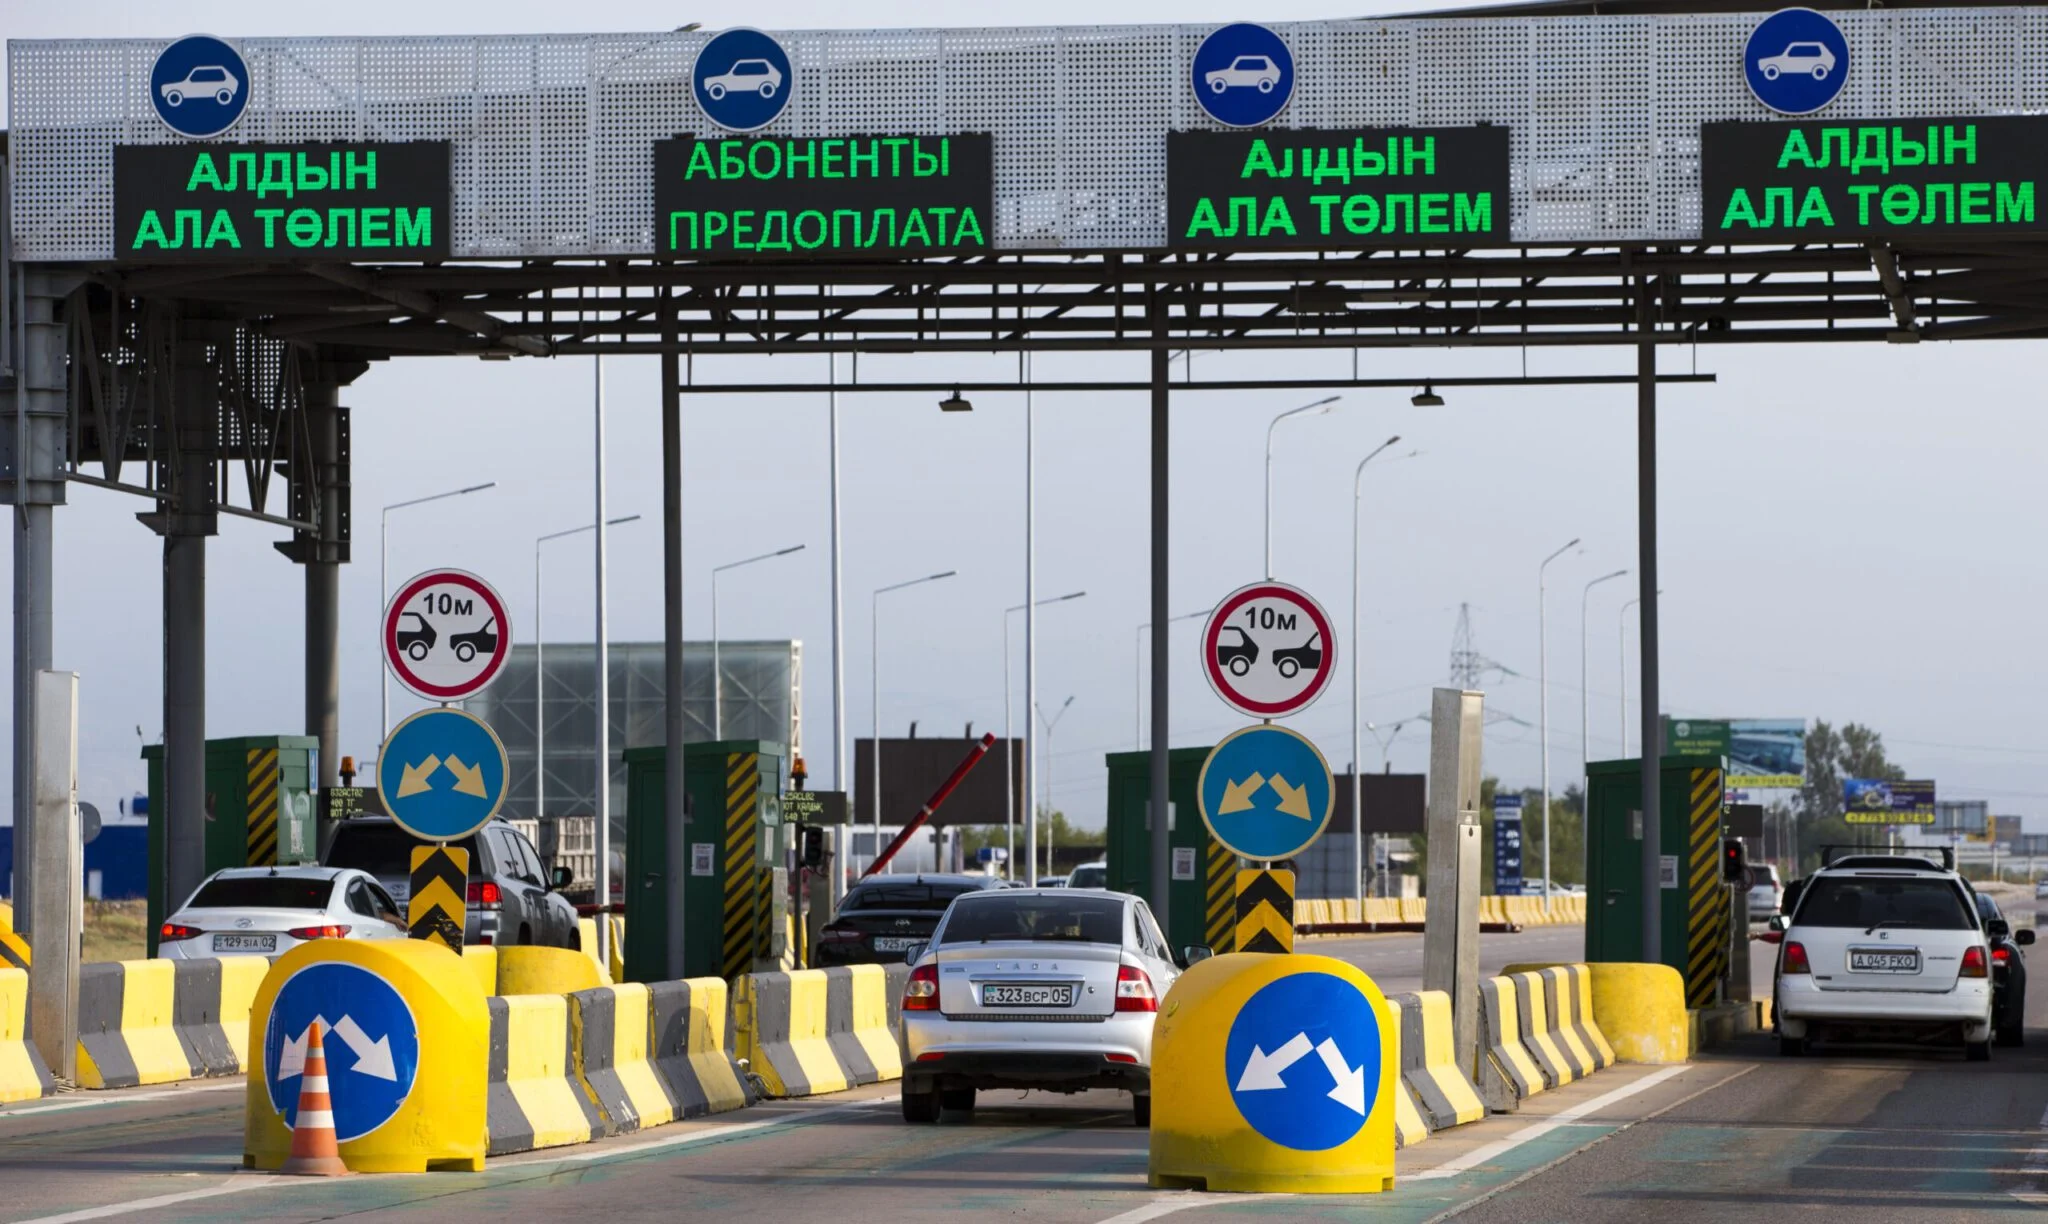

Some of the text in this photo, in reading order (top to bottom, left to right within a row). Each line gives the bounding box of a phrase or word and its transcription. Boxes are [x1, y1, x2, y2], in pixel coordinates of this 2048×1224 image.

[685, 138, 949, 180] АБОНЕНТЫ
[1778, 125, 1977, 175] АЛДЫН
[187, 152, 377, 198] АЛДЫН
[1186, 193, 1492, 237] АЛА ТӨЛЕМ
[1720, 182, 2035, 228] АЛА ТӨЛЕМ
[133, 207, 432, 249] АЛА ТӨЛЕМ
[670, 207, 985, 252] ПРЕДОПЛАТА
[1052, 988, 1069, 1003] 05
